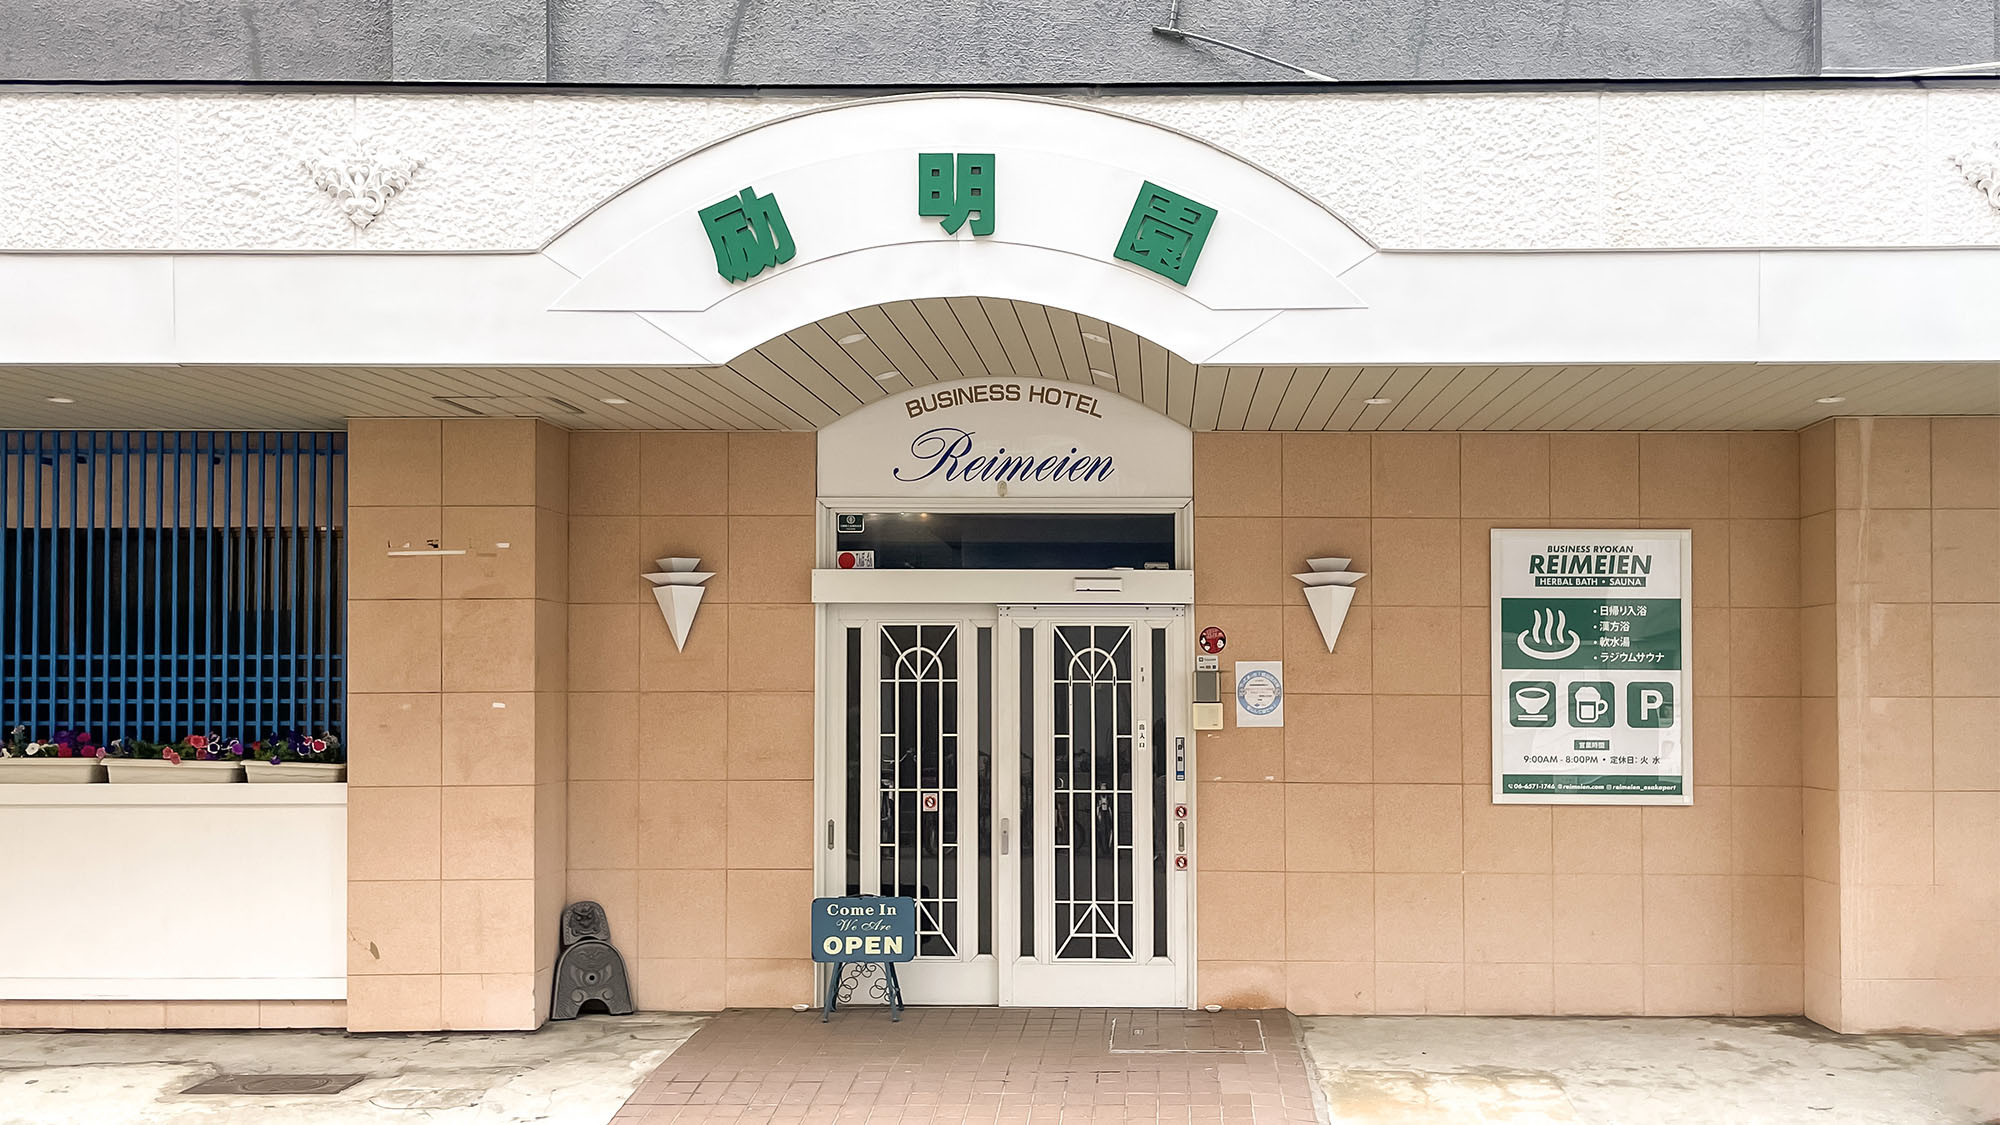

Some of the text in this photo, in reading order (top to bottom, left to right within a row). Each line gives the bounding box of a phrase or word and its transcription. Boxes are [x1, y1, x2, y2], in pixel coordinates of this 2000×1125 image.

[904, 384, 1103, 419] BUSINESS HOTEL
[893, 427, 1115, 482] Reimeien
[1547, 545, 1634, 553] BUSINESS RYOKAN
[1529, 554, 1652, 574] REIMEIEN
[1540, 578, 1642, 586] HERBAL BATH SAUNA
[1600, 605, 1647, 616] 日帰り入浴
[1599, 621, 1630, 632] 漢方浴
[1600, 652, 1665, 663] ラジウムサウナ
[1640, 689, 1663, 721] P
[1523, 755, 1558, 764] 9:00AM
[1565, 755, 1599, 764] 8:00PM
[1640, 756, 1649, 765] 火
[1652, 756, 1661, 765] 水
[826, 903, 897, 916] Come In
[836, 919, 892, 932] We Are
[823, 936, 903, 955] OPEN
